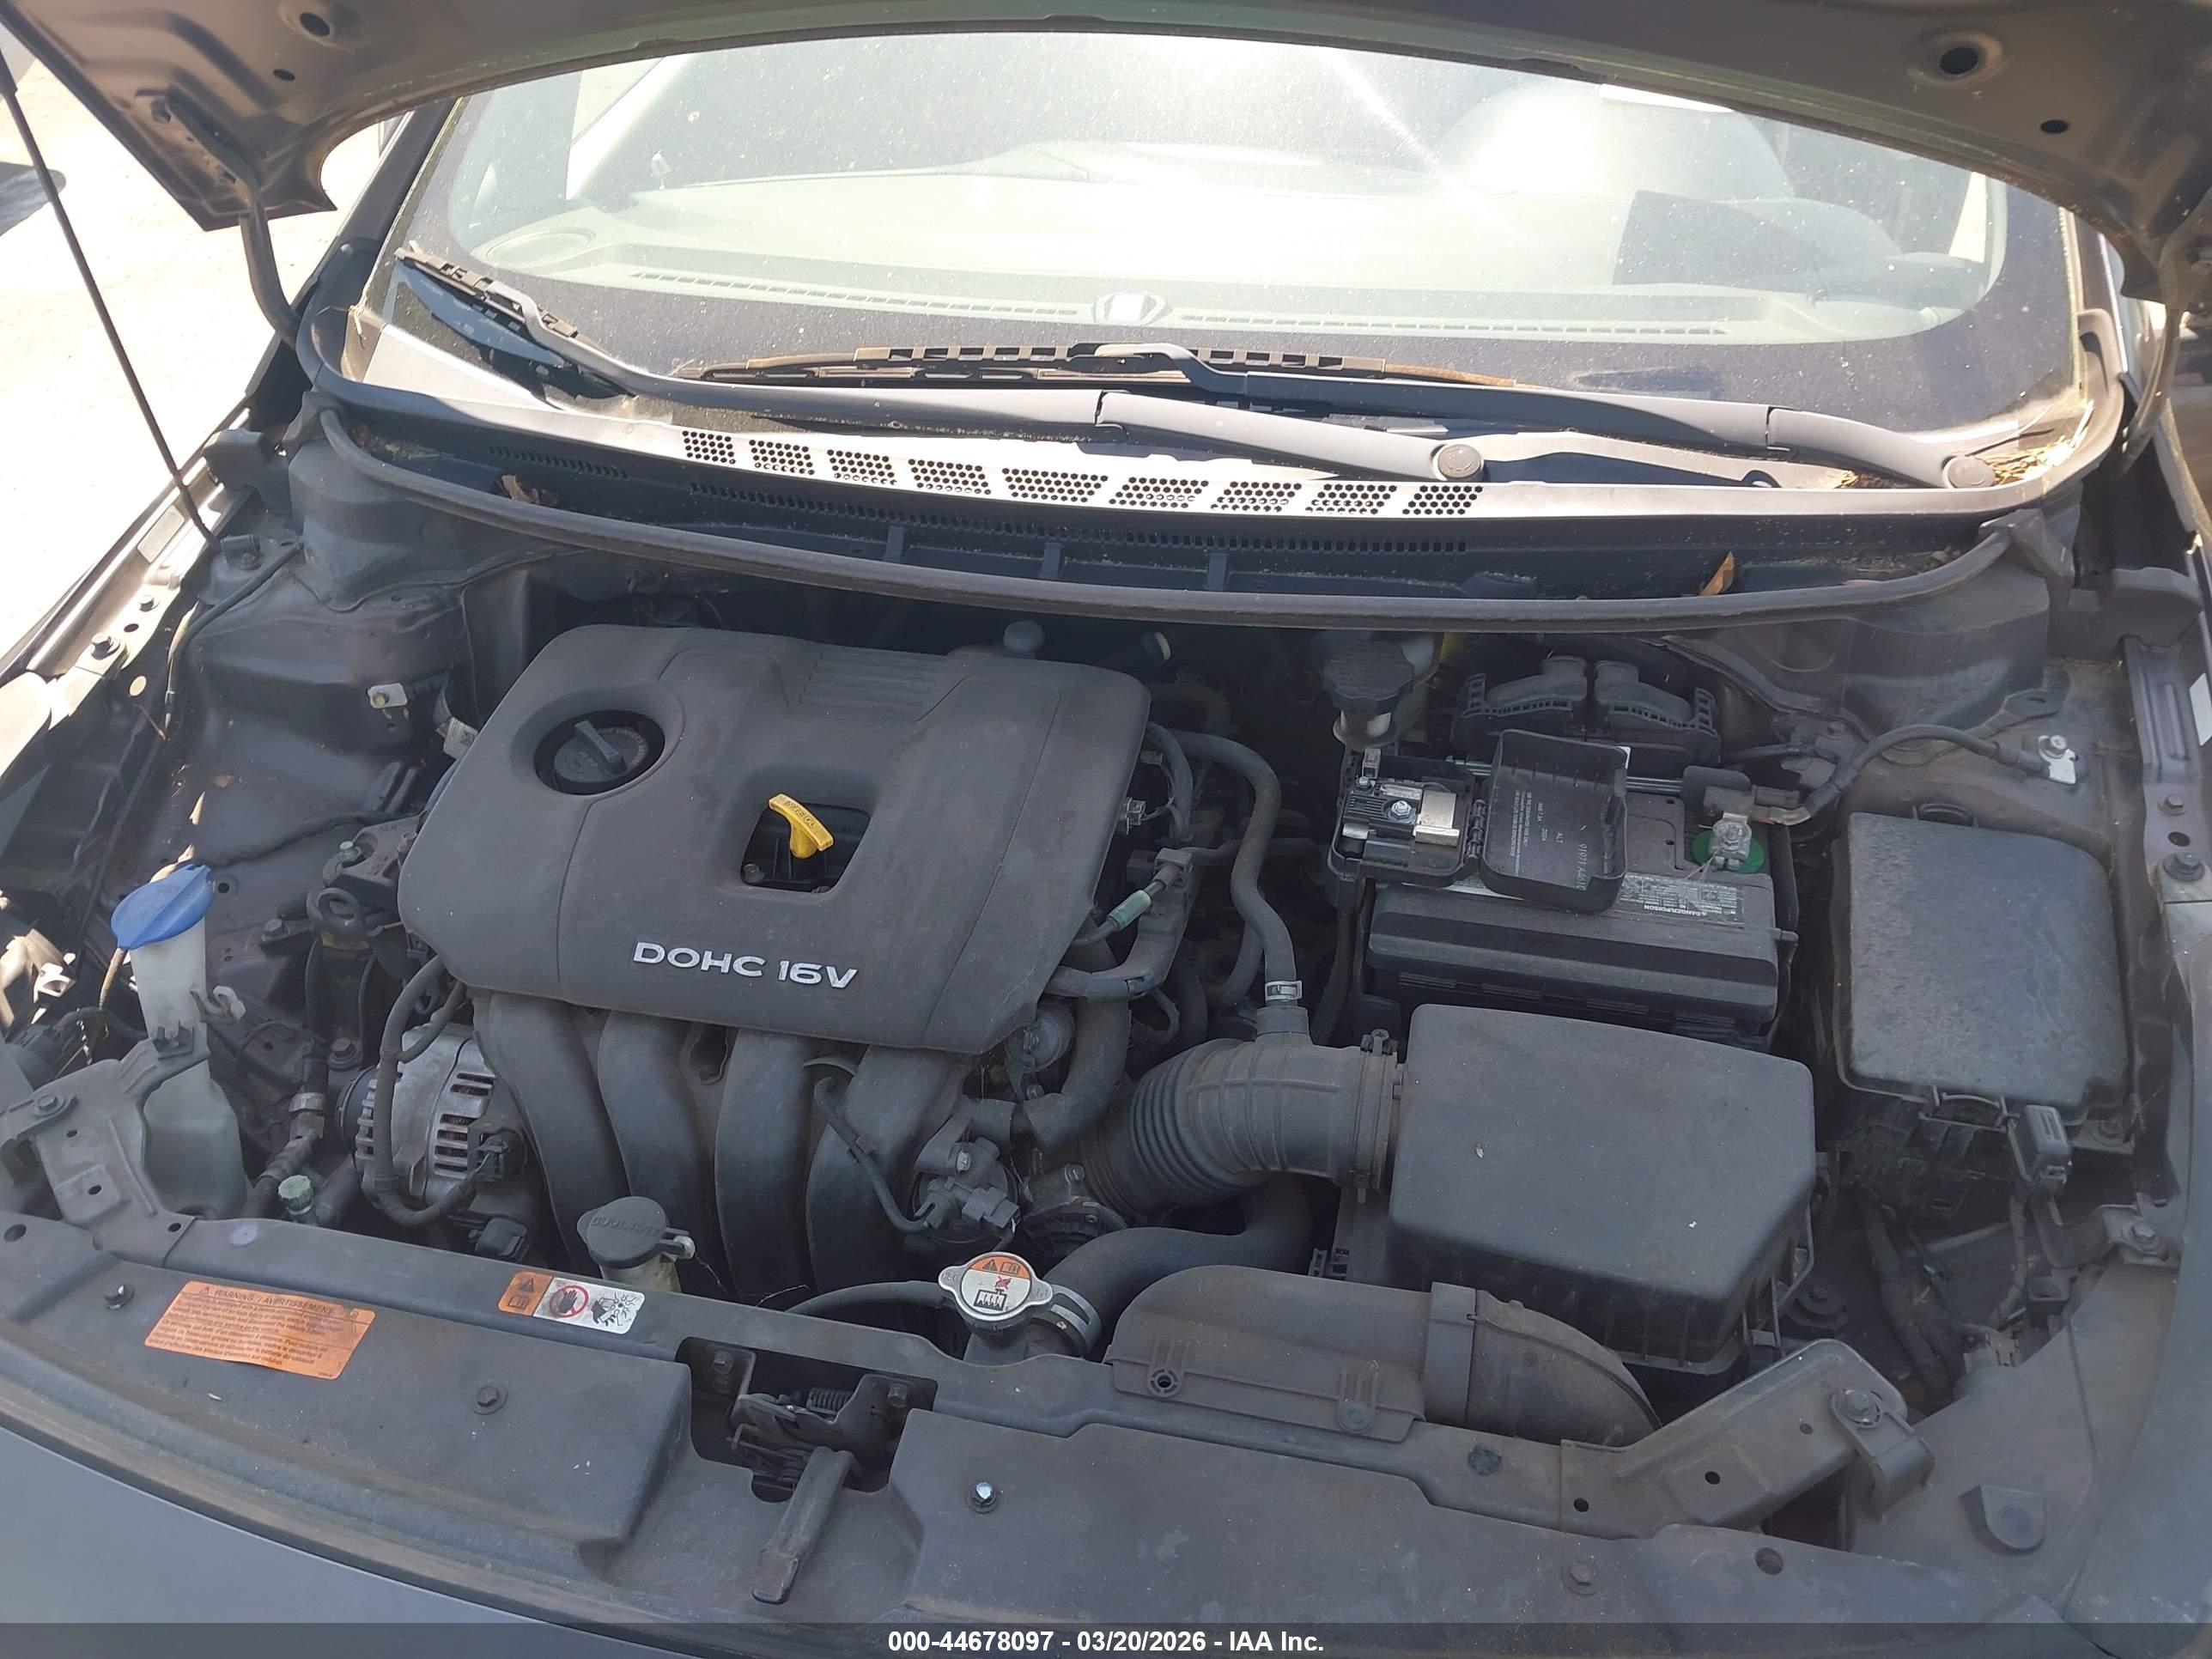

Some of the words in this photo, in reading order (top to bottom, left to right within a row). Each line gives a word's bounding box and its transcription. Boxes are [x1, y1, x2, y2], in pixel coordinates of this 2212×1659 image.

[633, 941, 766, 977] DOHC
[778, 960, 858, 988] 16V
[592, 1216, 660, 1237] COOLANT
[214, 1289, 255, 1302] WARNING
[264, 1297, 332, 1314] AVERTISSEMENT
